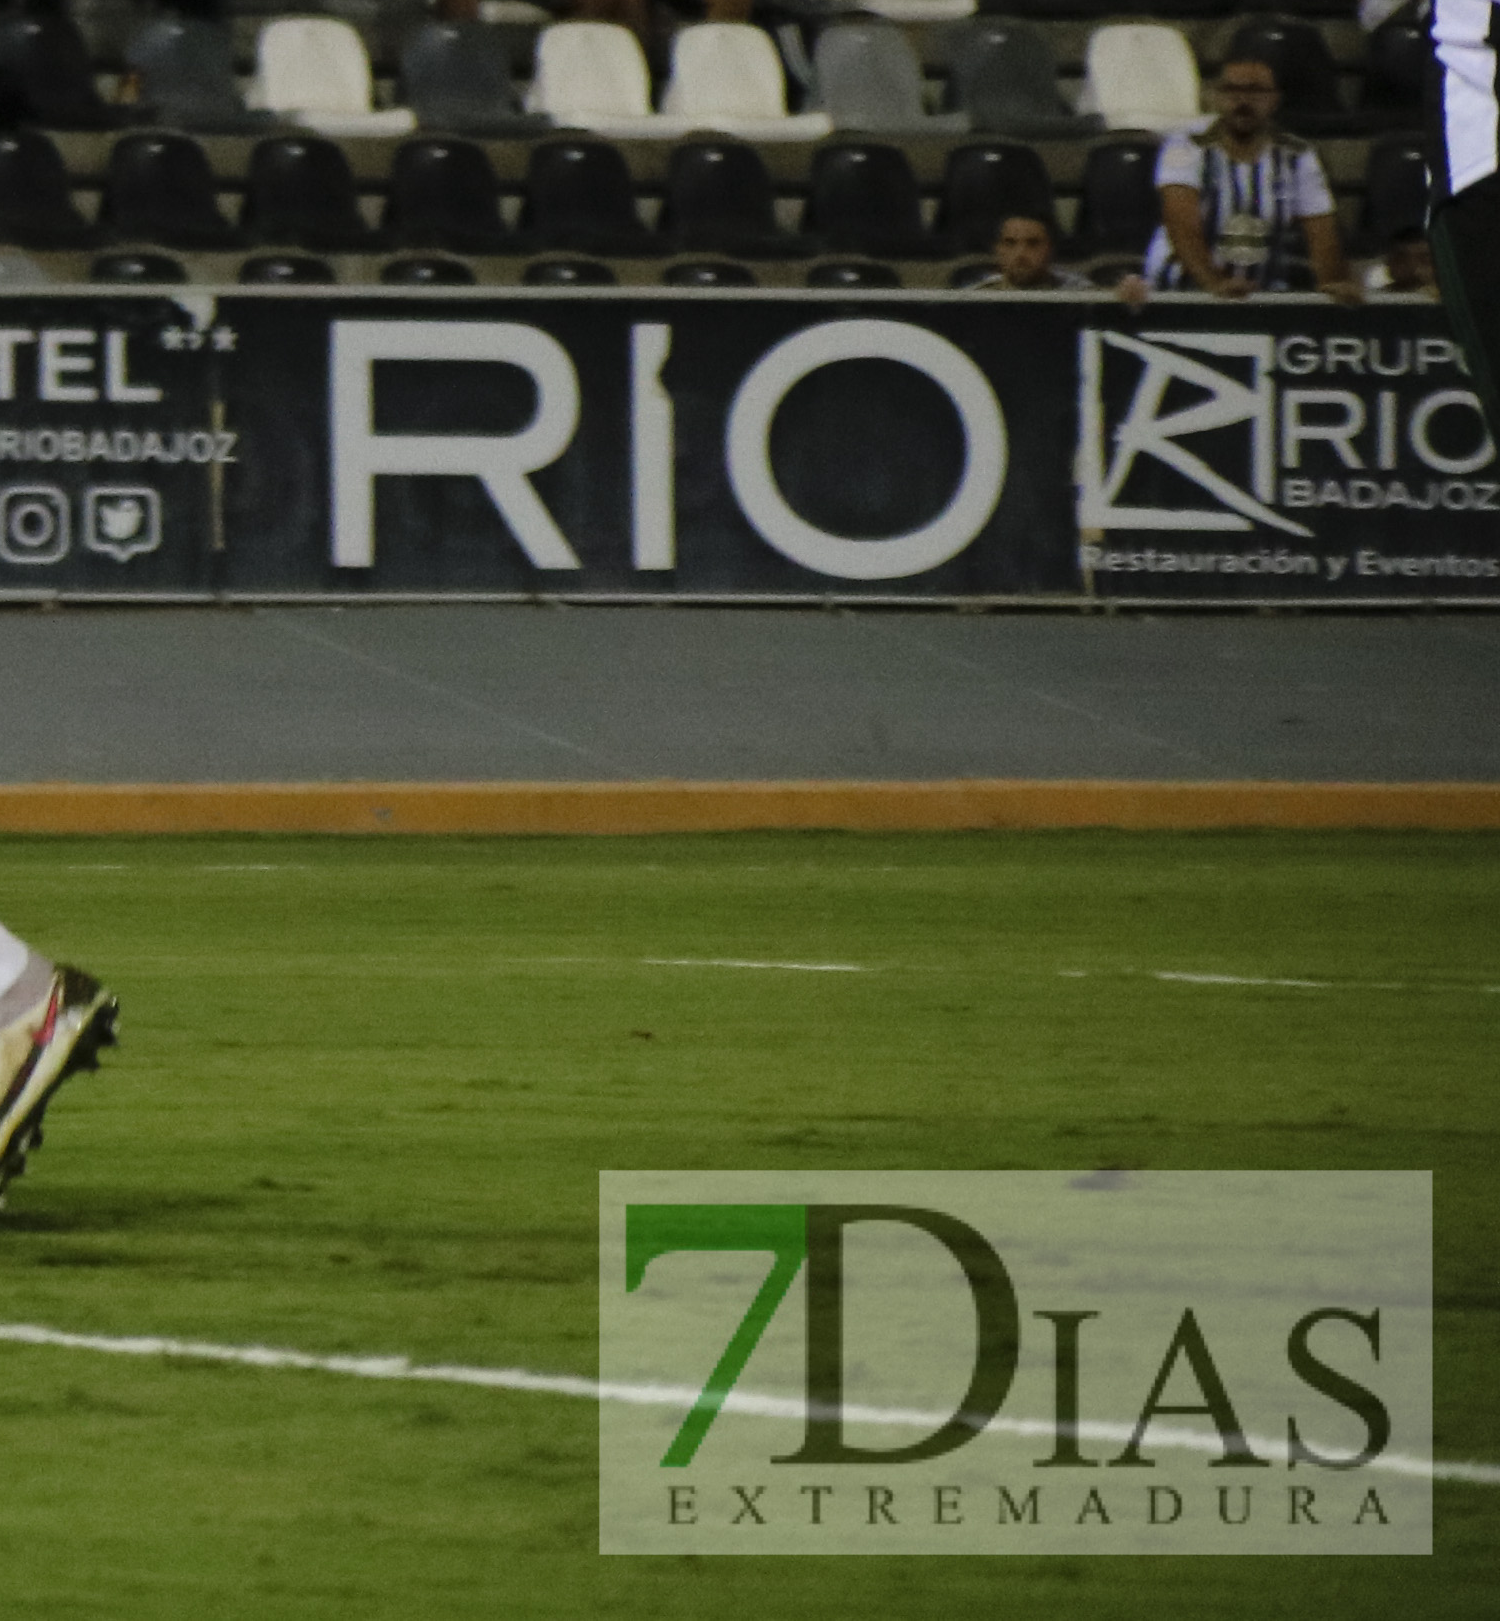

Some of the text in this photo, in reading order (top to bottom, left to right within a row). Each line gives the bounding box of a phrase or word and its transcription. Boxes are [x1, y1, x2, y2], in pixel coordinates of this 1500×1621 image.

[1276, 335, 1470, 376] GRUP
[329, 318, 1010, 579] RIO
[1282, 388, 1497, 474] RIO
[1282, 479, 1500, 511] BADAJOZ
[1326, 556, 1351, 581] y
[1356, 549, 1500, 577] Eventos
